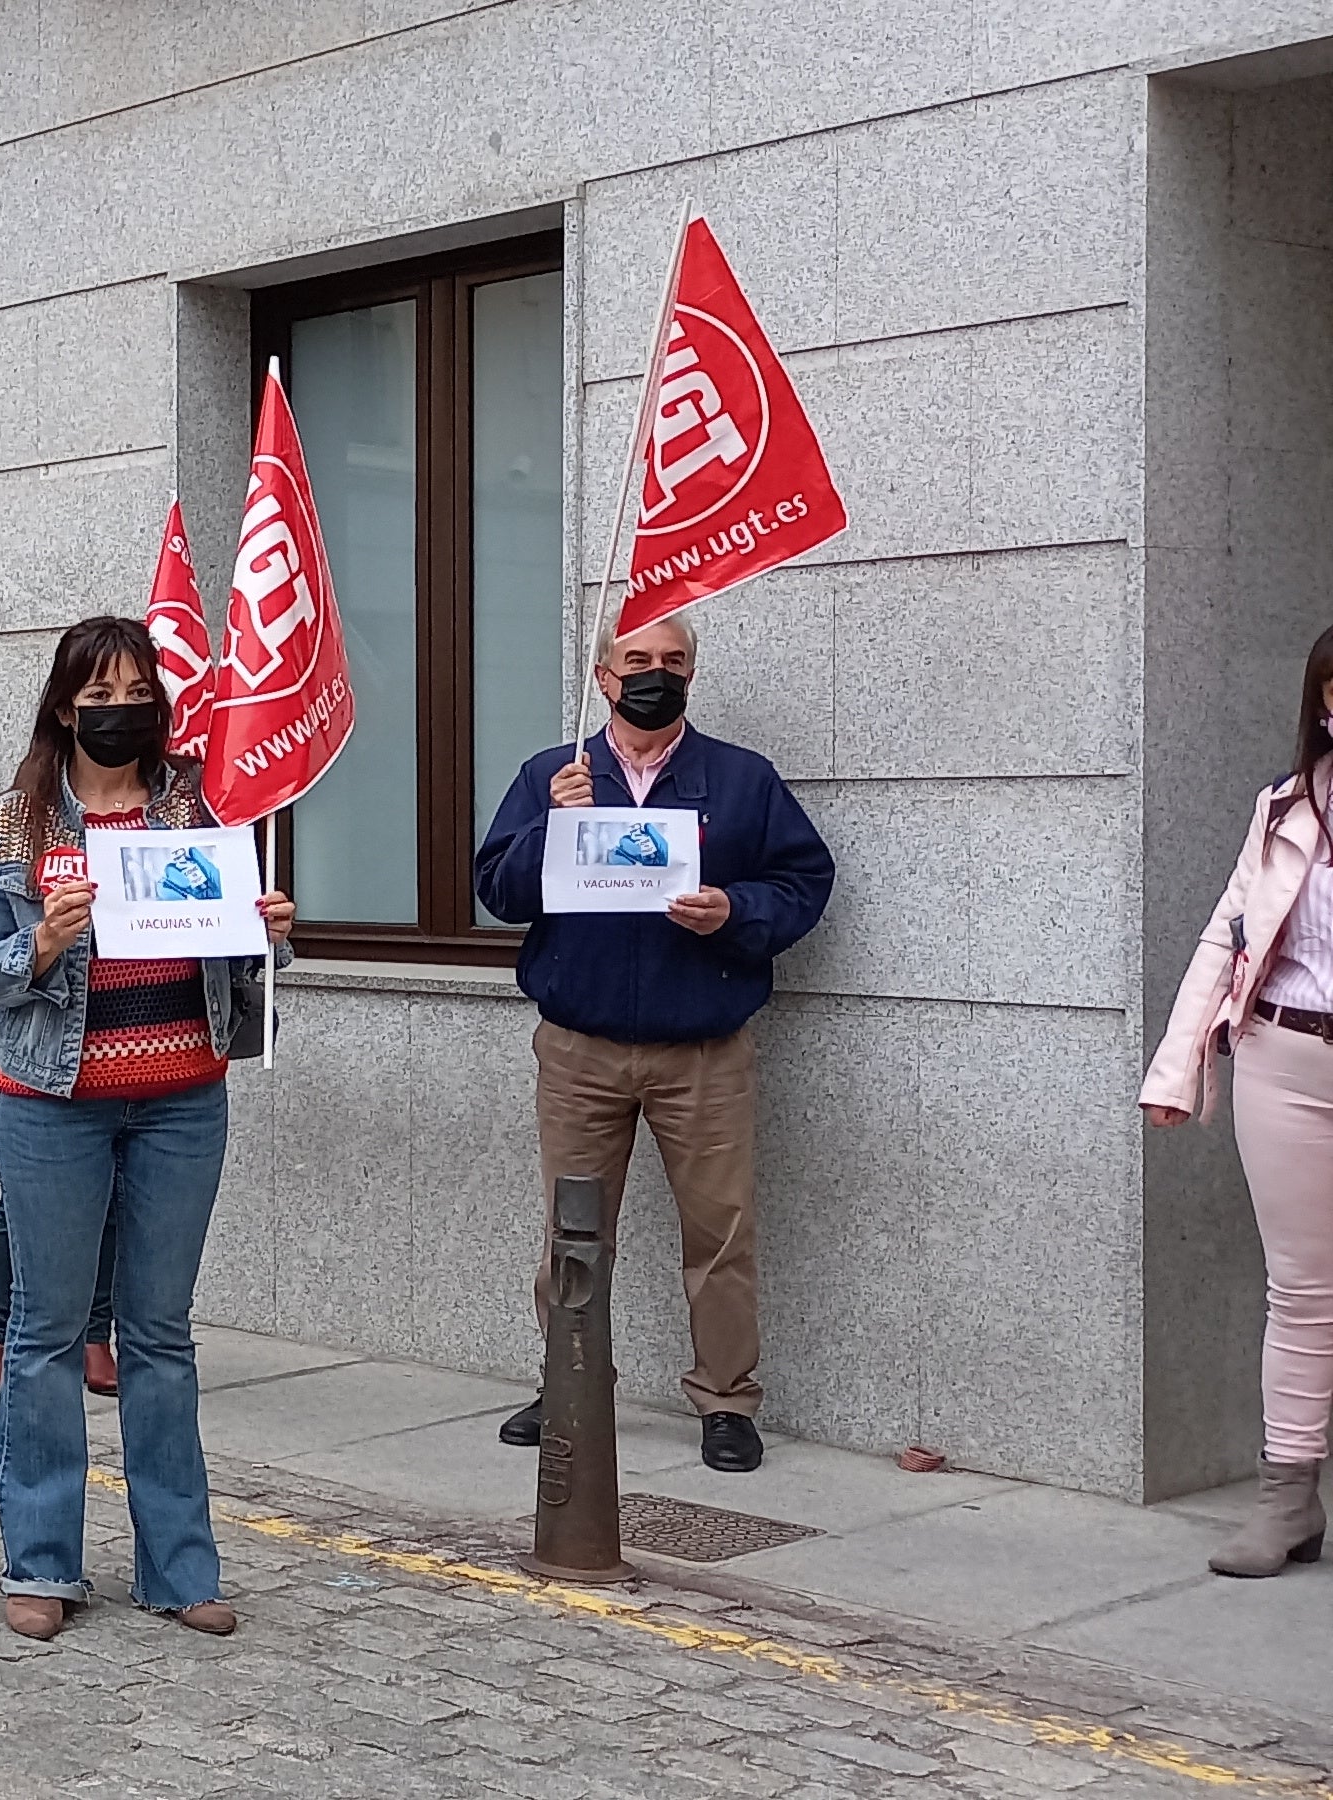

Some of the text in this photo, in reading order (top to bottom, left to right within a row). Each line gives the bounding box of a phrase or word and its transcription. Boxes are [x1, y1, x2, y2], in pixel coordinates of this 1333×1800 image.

[43, 855, 86, 876] UGT
[583, 879, 635, 889] VACUNAS
[640, 879, 653, 887] YA
[136, 918, 192, 930] VACUNAS
[197, 917, 214, 928] YA
